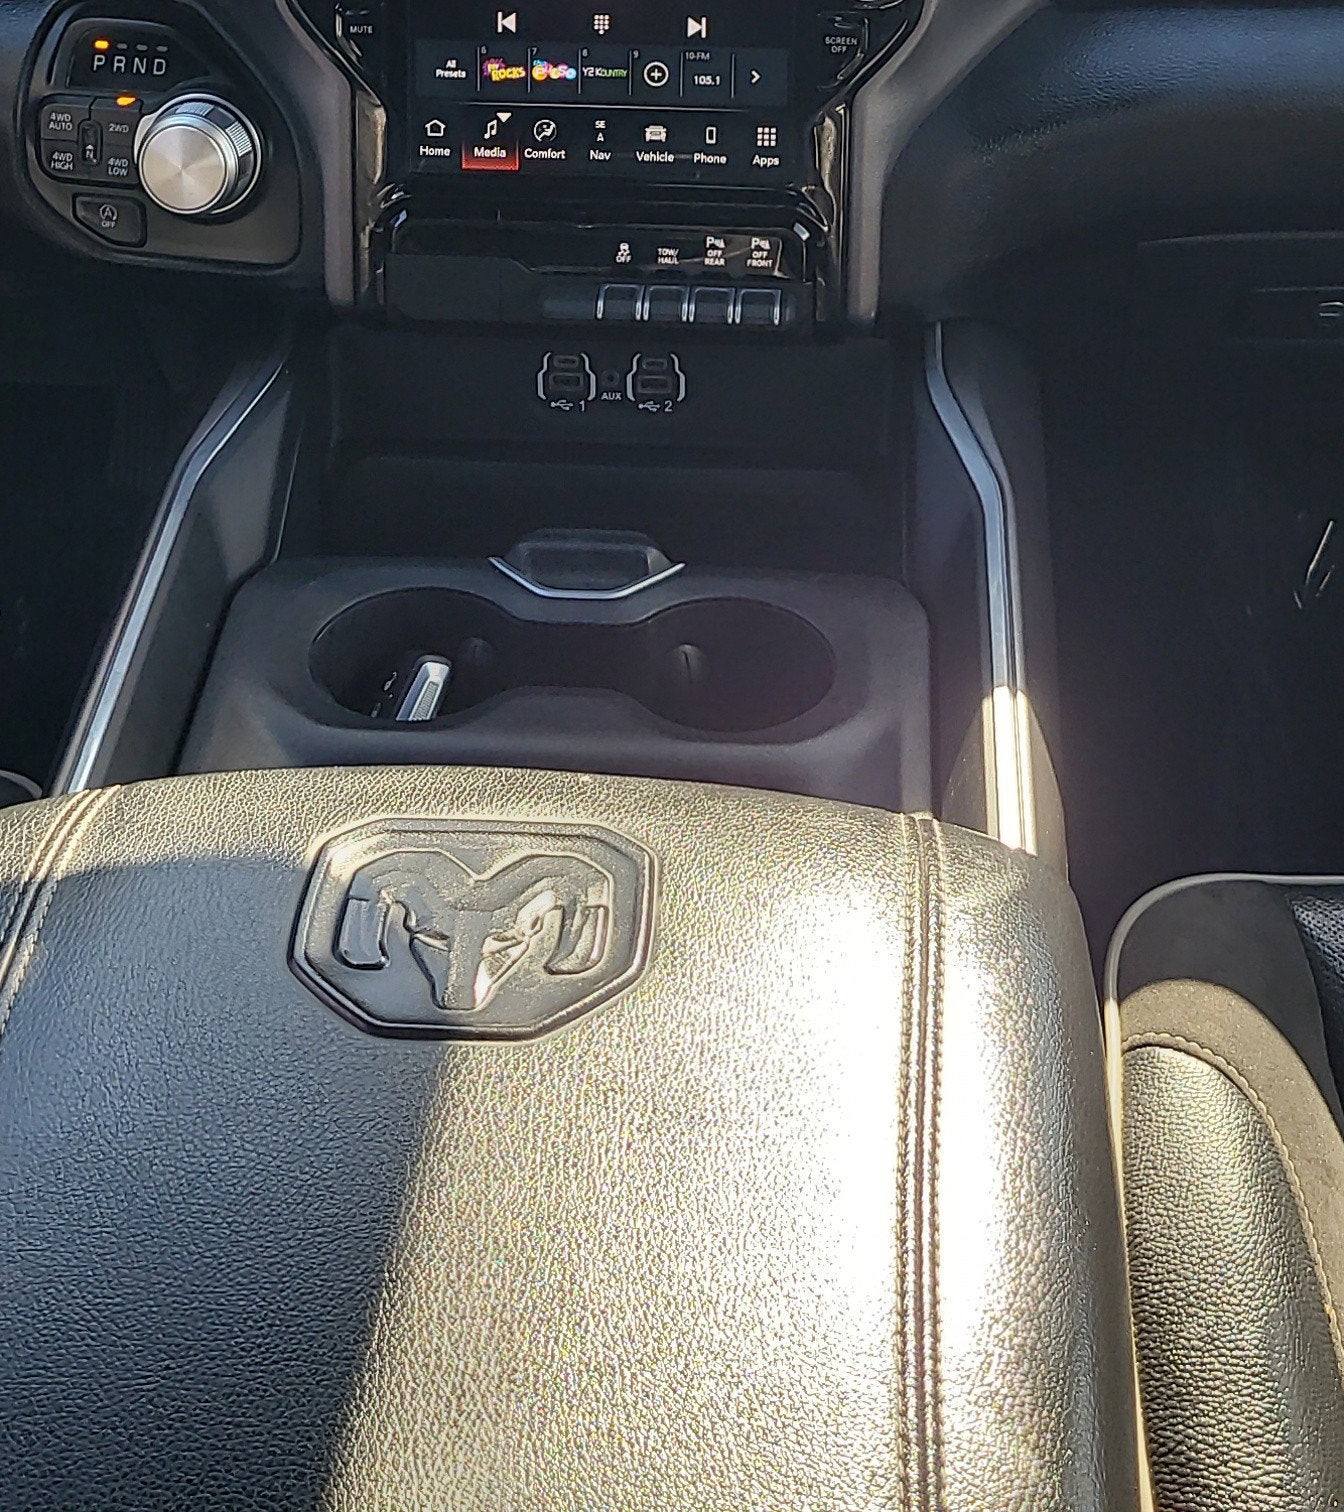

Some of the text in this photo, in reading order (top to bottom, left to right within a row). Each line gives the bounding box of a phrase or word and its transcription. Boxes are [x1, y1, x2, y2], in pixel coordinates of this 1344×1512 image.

[349, 25, 373, 34] MUTE
[825, 36, 857, 45] SCREEN
[831, 45, 847, 53] OFF
[685, 51, 711, 60] 10-FM
[446, 59, 457, 68] All
[435, 69, 467, 78] Presets
[491, 65, 526, 82] ROCKS
[694, 75, 721, 85] 105.1
[50, 112, 71, 122] 4WD
[48, 121, 73, 131] AUTO
[109, 123, 130, 133] 2WD
[419, 145, 451, 157] Home
[474, 146, 507, 158] Media
[524, 148, 566, 160] Comfort
[589, 149, 611, 161] Nav
[52, 151, 73, 162] 4WD
[636, 150, 675, 163] Vehicle
[693, 152, 727, 164] Phone
[752, 155, 779, 168] Apps
[50, 160, 73, 171] HIGH
[107, 157, 128, 167] 4WD
[108, 166, 128, 176] LOW
[101, 220, 116, 228] OFF
[616, 255, 632, 263] OFF
[707, 250, 723, 258] OFF
[752, 251, 768, 259] OFF
[657, 256, 679, 264] HAUL
[704, 258, 725, 266] REAR
[747, 259, 773, 268] FRONT
[601, 391, 622, 401] AUX
[664, 400, 673, 412] 2
